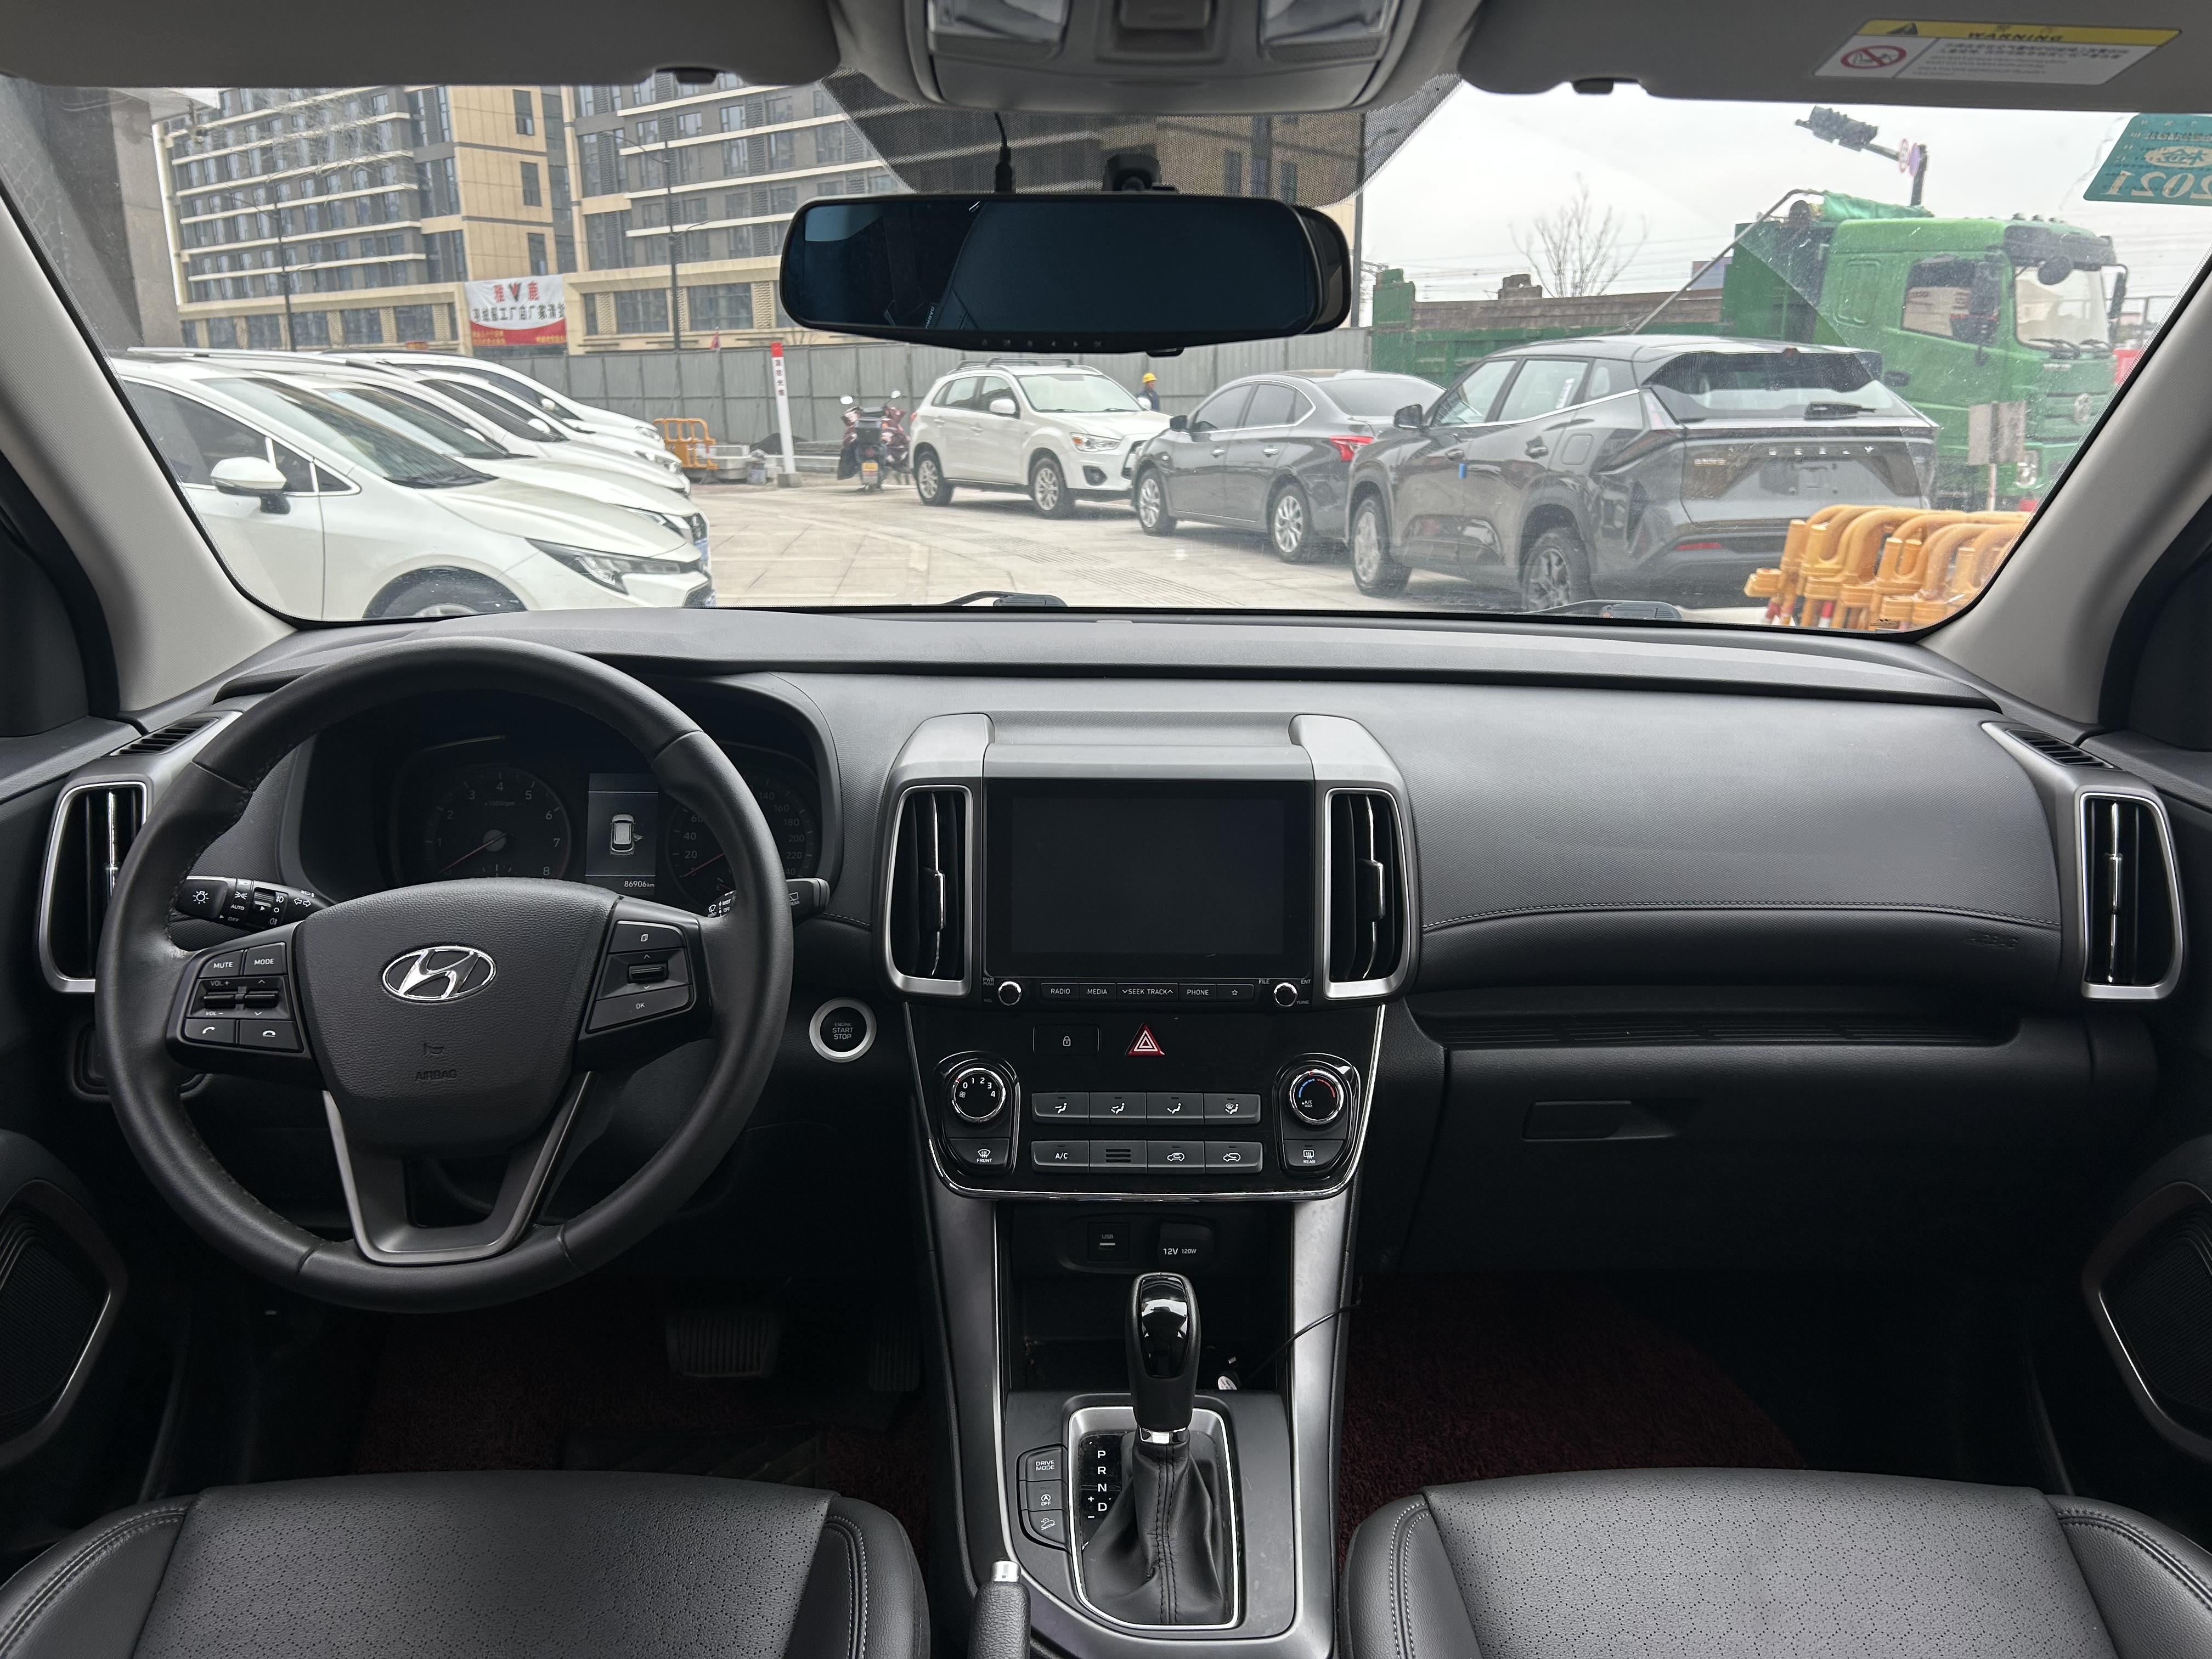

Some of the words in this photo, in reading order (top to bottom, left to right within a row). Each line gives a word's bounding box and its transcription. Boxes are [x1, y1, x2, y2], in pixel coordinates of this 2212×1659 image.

[1968, 32, 2062, 41] WARNING
[496, 782, 504, 791] 4
[469, 791, 475, 800] 3
[526, 791, 532, 800] 5
[447, 811, 454, 819] 2
[545, 811, 552, 820] 6
[554, 838, 560, 847] 7
[543, 867, 550, 876] 8
[415, 1069, 457, 1081] AIRBAG
[1098, 1466, 1107, 1475] R
[1098, 1483, 1107, 1492] N
[1098, 1503, 1107, 1511] D
